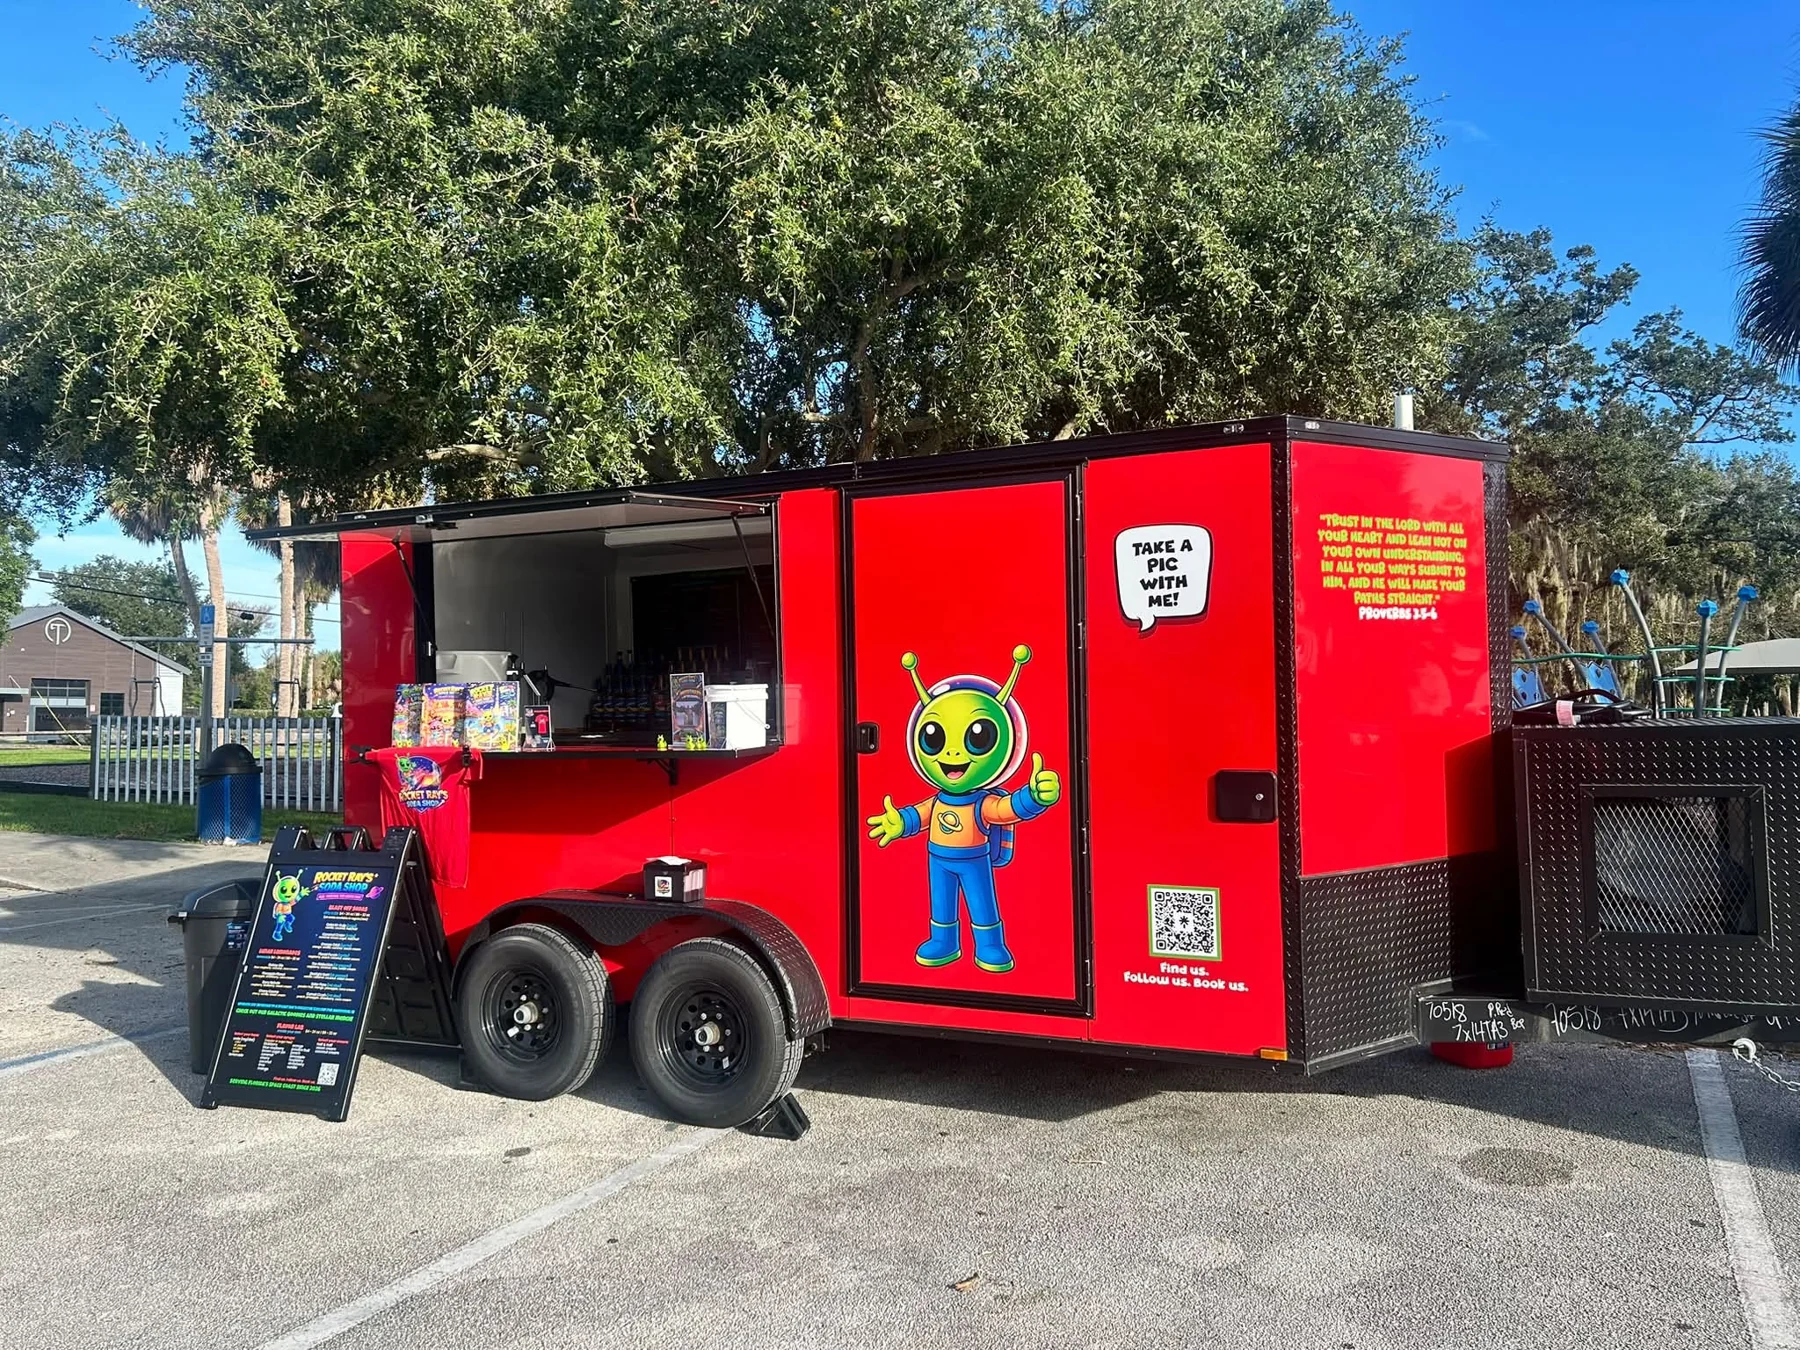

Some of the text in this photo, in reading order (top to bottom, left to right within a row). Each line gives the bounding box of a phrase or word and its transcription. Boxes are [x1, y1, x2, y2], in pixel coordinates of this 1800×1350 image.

[1362, 516, 1372, 528] IN
[1376, 517, 1394, 529] THE
[1396, 519, 1420, 531] LORD
[1423, 521, 1447, 533] WITH
[1449, 523, 1464, 534] ALL
[1318, 529, 1467, 548] YOUR HEART AND LEAN NOT ON
[1132, 539, 1193, 555] TAKE A
[1322, 545, 1352, 557] YOUR
[1355, 547, 1380, 558] OWN
[1147, 558, 1178, 573] PIC
[1321, 560, 1465, 577] IN ALL YOUR WAYS SUBMIT TO
[1140, 575, 1188, 591] WITH
[1323, 576, 1465, 591] HIM, AND HE WILL MAKE YOUR
[1148, 593, 1179, 608] ME!
[1354, 591, 1385, 604] PATHS
[1359, 606, 1411, 620] PROVERBS
[313, 872, 373, 884] ROCKET RAY'S
[318, 883, 368, 892] SODA SHOP
[1160, 962, 1209, 976] Find us.
[1123, 971, 1249, 992] Follow us. Book us.
[1426, 1001, 1467, 1022] 70518
